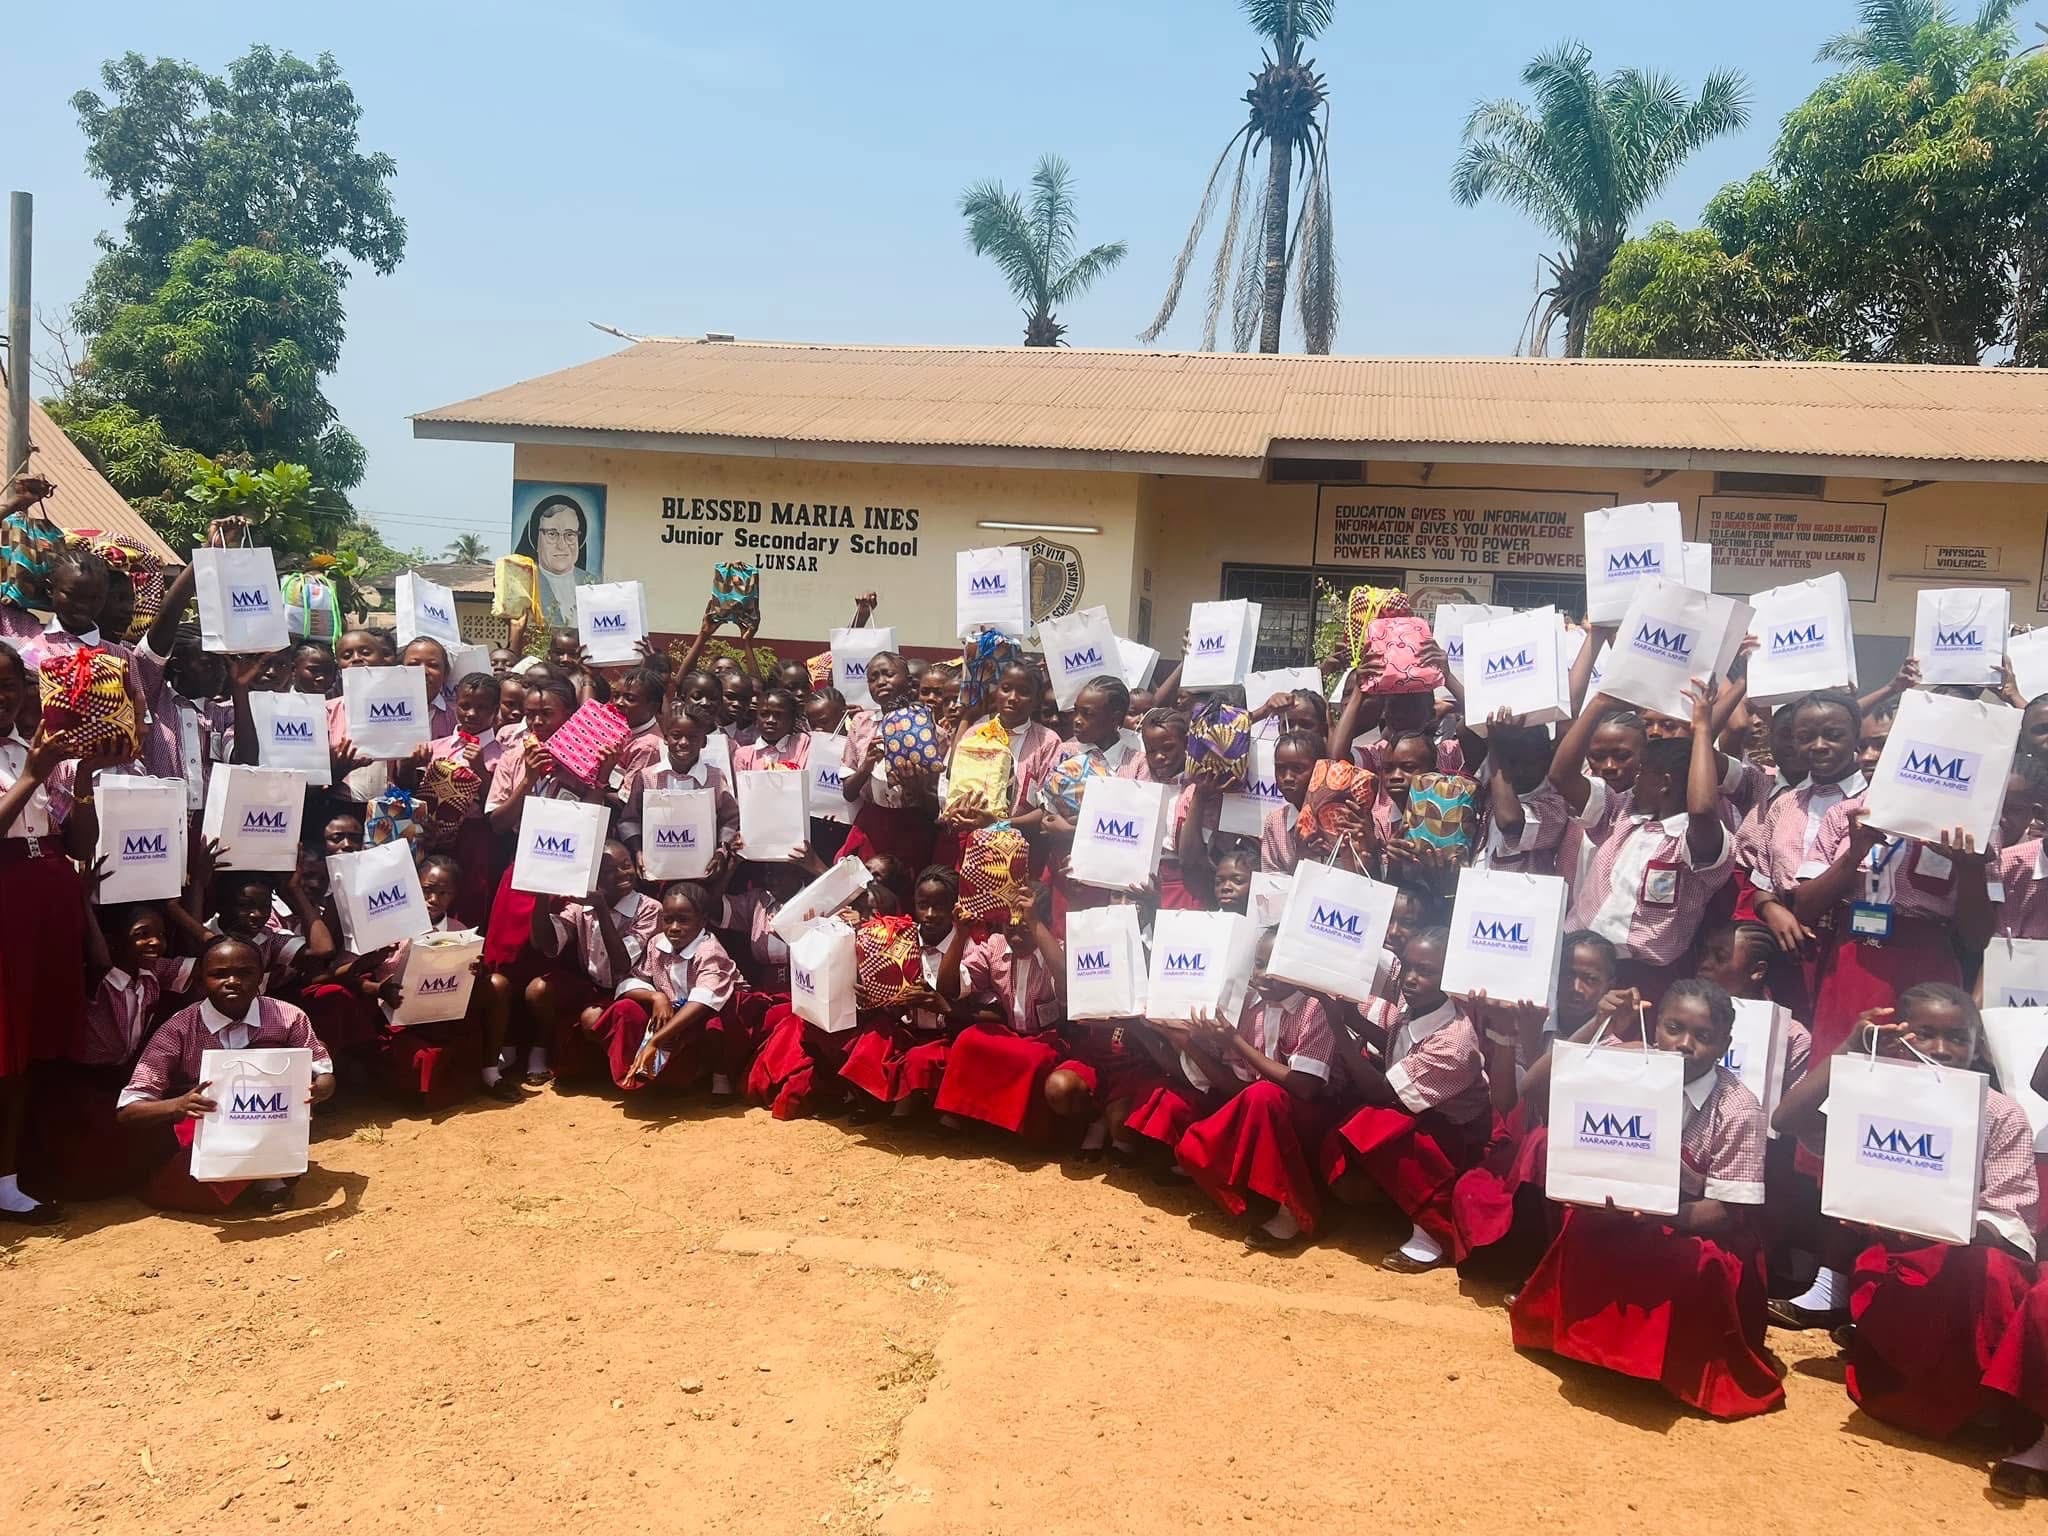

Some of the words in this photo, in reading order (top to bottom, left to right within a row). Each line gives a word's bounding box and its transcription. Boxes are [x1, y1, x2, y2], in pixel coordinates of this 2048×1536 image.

[662, 497, 762, 523] BLESSED
[771, 502, 855, 528] MARIA
[864, 506, 920, 531] INES
[1335, 505, 1406, 518] EDUCATION
[1411, 507, 1446, 520] GIVES
[1453, 509, 1475, 521] YOU
[1483, 509, 1567, 524] INFORMATION
[1712, 511, 1722, 520] TO
[1724, 511, 1746, 520] READ
[1747, 512, 1754, 520] IS
[1756, 513, 1772, 521] ONE
[1335, 519, 1414, 533] INFORMATION
[1420, 522, 1458, 535] GIVES
[1463, 523, 1489, 535] YOU
[1493, 524, 1575, 539] KNOWLEDGE
[1721, 521, 1772, 530] UNDERSTAND
[1773, 522, 1794, 531] WHAT
[661, 524, 723, 546] Junior
[734, 528, 839, 555] Secondary
[850, 534, 918, 557] School
[1334, 533, 1411, 546] KNOWLEDGE
[1415, 535, 1449, 547] GIVES
[1454, 536, 1478, 549] YOU
[1482, 537, 1530, 551] POWER
[1709, 529, 1719, 538] TO
[1720, 529, 1747, 539] LEARN
[1748, 530, 1770, 539] FROM
[1772, 532, 1793, 541] WHAT
[1796, 532, 1811, 541] YOU
[1813, 533, 1866, 543] UNDERSTAND
[1867, 535, 1876, 544] IS
[1753, 540, 1776, 549] ELSE
[1032, 543, 1046, 556] EST
[1046, 547, 1066, 562] VITA
[1334, 546, 1380, 559] POWER
[1384, 547, 1426, 559] MAKES
[1431, 548, 1455, 560] YOU
[1460, 549, 1477, 562] TO
[1482, 551, 1500, 564] BE
[1507, 552, 1585, 567] EMPOWERE
[1608, 549, 1660, 572] MML
[1728, 548, 1739, 557] TO
[1741, 548, 1757, 557] ACT
[1760, 549, 1773, 558] ON
[1776, 550, 1802, 559] WHAT
[1805, 551, 1822, 560] YOU
[1825, 551, 1855, 561] LEARN
[1857, 552, 1866, 561] IS
[1938, 548, 1987, 558] PHYSICAL
[755, 553, 818, 572] LUNSAR
[1734, 557, 1766, 567] REALLY
[1769, 558, 1812, 568] MATTERS
[971, 575, 1006, 591] MML
[1419, 573, 1464, 584] Sponsored
[231, 590, 268, 607] MML
[1052, 592, 1075, 618] SCHOOL
[1066, 561, 1079, 592] LUNSAR
[423, 603, 450, 621] MML
[593, 614, 626, 629] MML
[1197, 635, 1225, 651] MML
[1633, 622, 1692, 656] MML
[1773, 624, 1824, 649] MML
[1936, 630, 1982, 646] MML
[1065, 648, 1102, 670] MML
[1486, 650, 1534, 674] MML
[846, 663, 868, 676] MM
[370, 701, 411, 718] MML
[275, 721, 311, 737] MML
[1903, 749, 1971, 782] MML
[1900, 772, 1940, 785] MARAMPA
[1942, 780, 1969, 791] MINES
[243, 811, 288, 828] MML
[1096, 818, 1140, 839] MML
[122, 834, 167, 854] MML
[533, 835, 574, 854] MML
[656, 829, 696, 843] MML
[369, 885, 407, 911] MML
[1312, 904, 1363, 935] MML
[1474, 919, 1529, 943] MML
[1077, 951, 1110, 969] MML
[1166, 953, 1206, 970] MML
[419, 975, 458, 992] MML
[231, 1092, 289, 1111] MML
[1581, 1111, 1651, 1140] MML
[1580, 1136, 1624, 1147] MARAMPA
[1625, 1140, 1650, 1150] MINES
[1865, 1123, 1945, 1160] MML
[1863, 1150, 1913, 1165] MARAMPA
[1914, 1160, 1943, 1171] MINES
